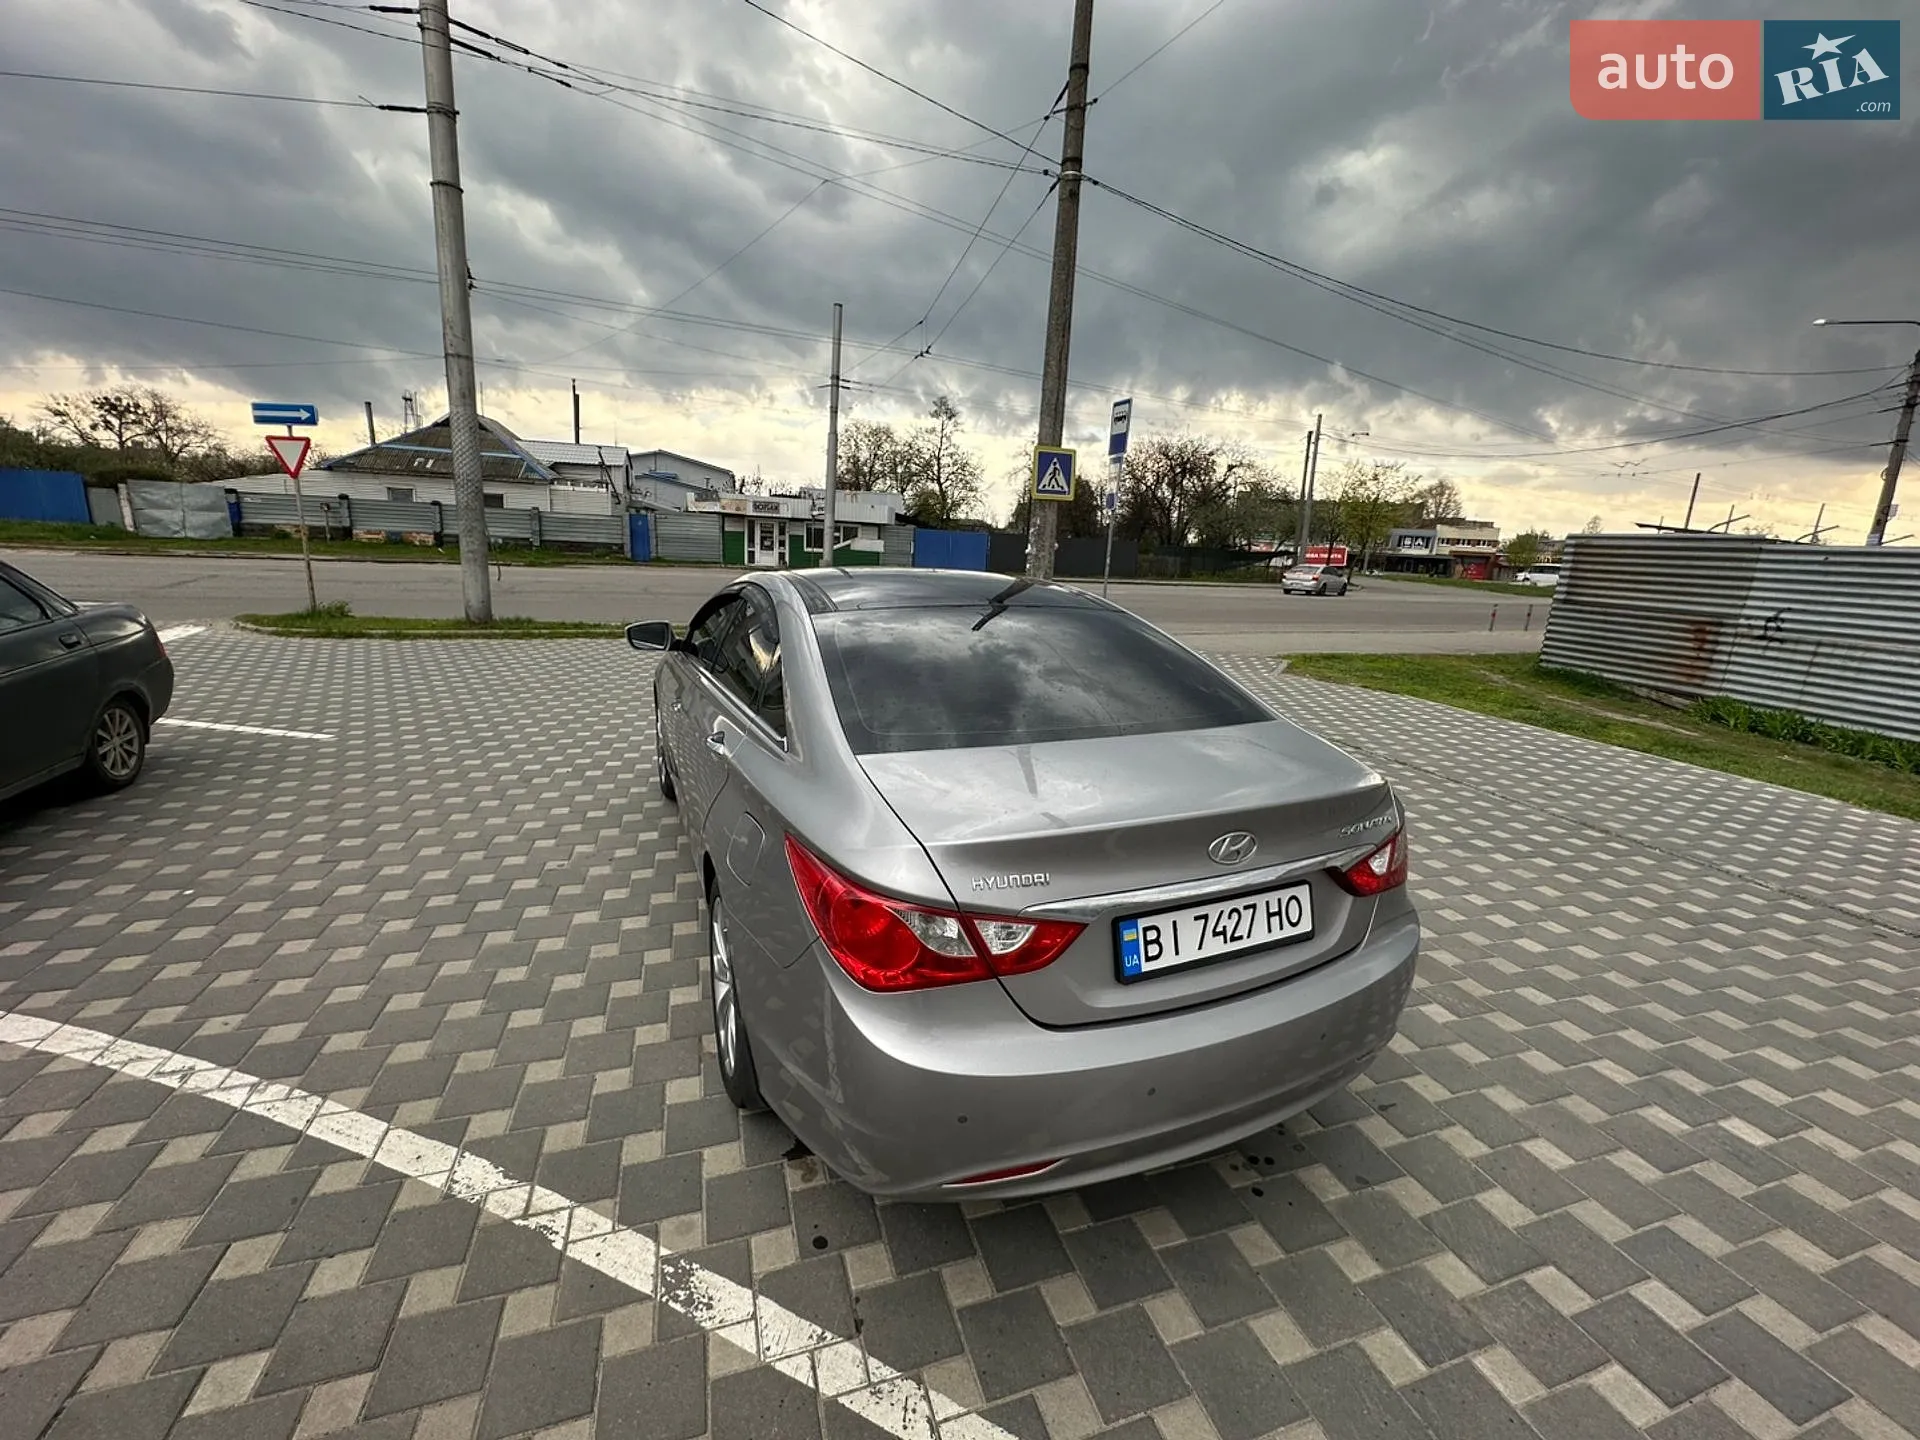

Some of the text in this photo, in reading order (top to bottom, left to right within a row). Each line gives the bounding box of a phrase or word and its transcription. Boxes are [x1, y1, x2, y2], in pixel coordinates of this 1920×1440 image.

[971, 872, 1050, 890] HYUNDAI
[1142, 894, 1303, 963] BI 7427 HO
[1124, 954, 1140, 968] UA
